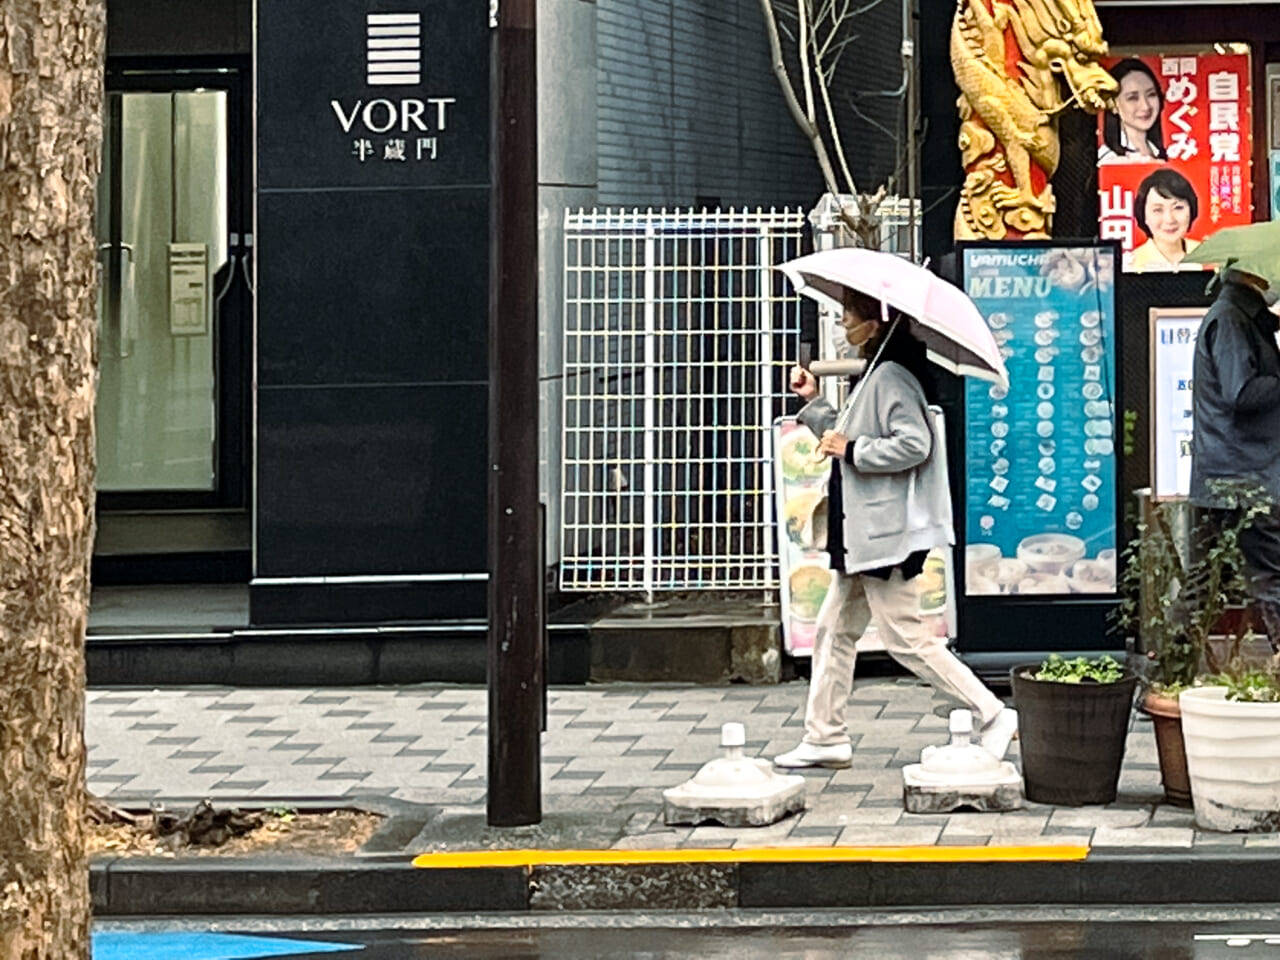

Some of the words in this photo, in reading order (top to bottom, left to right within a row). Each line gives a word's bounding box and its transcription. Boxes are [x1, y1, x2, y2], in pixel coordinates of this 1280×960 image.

[331, 98, 456, 133] VORT
[1164, 77, 1198, 161] めぐみ
[1208, 72, 1240, 162] 自民党
[352, 137, 437, 161] 半蔵門
[968, 277, 1051, 298] MENU
